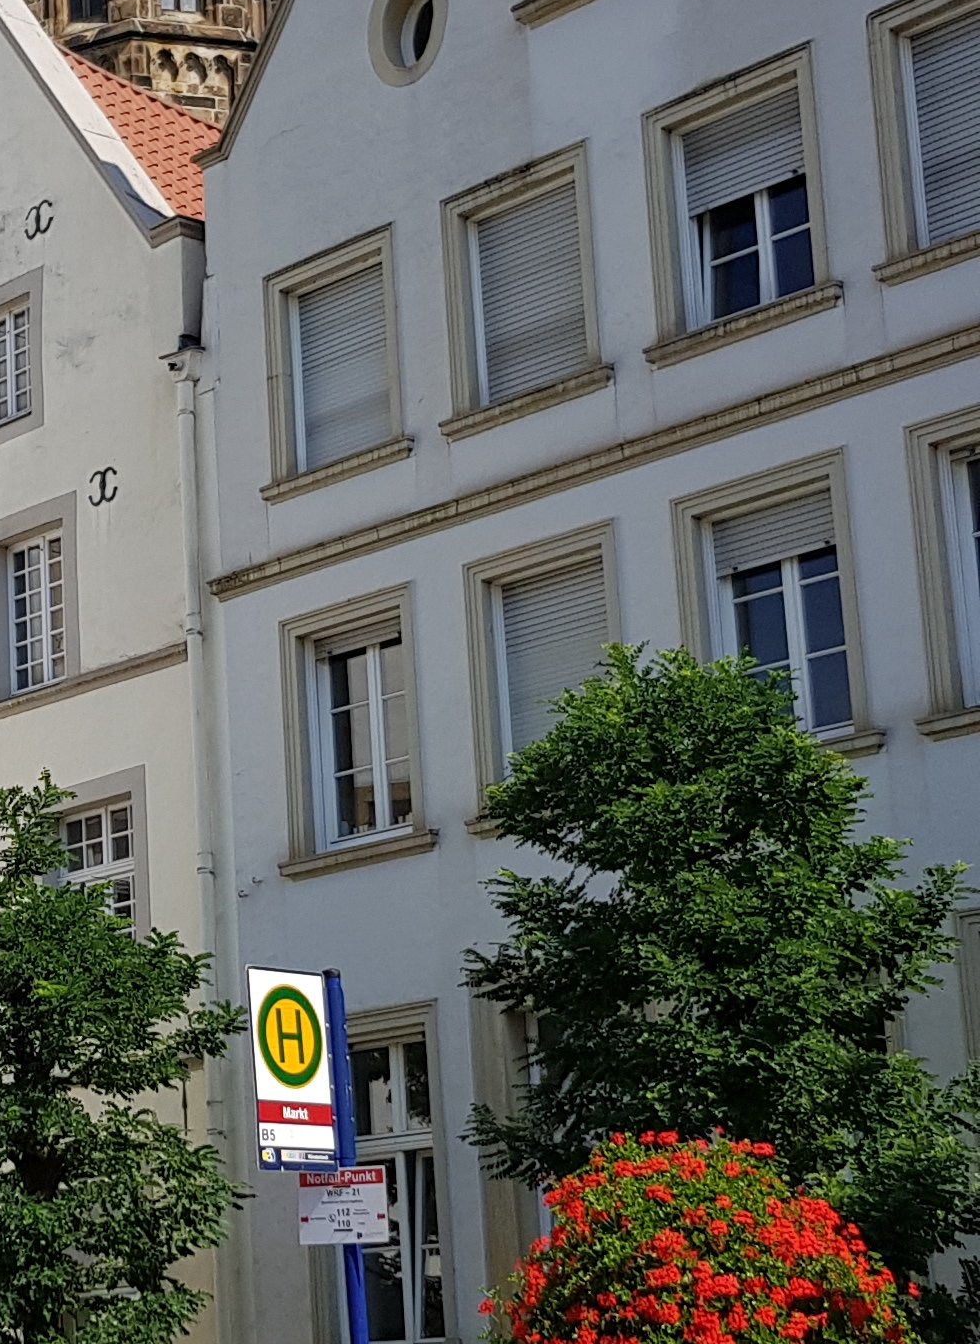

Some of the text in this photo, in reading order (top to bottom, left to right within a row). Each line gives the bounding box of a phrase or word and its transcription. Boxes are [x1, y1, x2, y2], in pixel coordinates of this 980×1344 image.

[275, 1007, 305, 1064] H
[282, 1105, 309, 1120] Markt
[261, 1128, 276, 1142] B5
[306, 1170, 377, 1185] Notfall-Punkt
[336, 1207, 350, 1217] 112
[337, 1219, 351, 1228] 110
